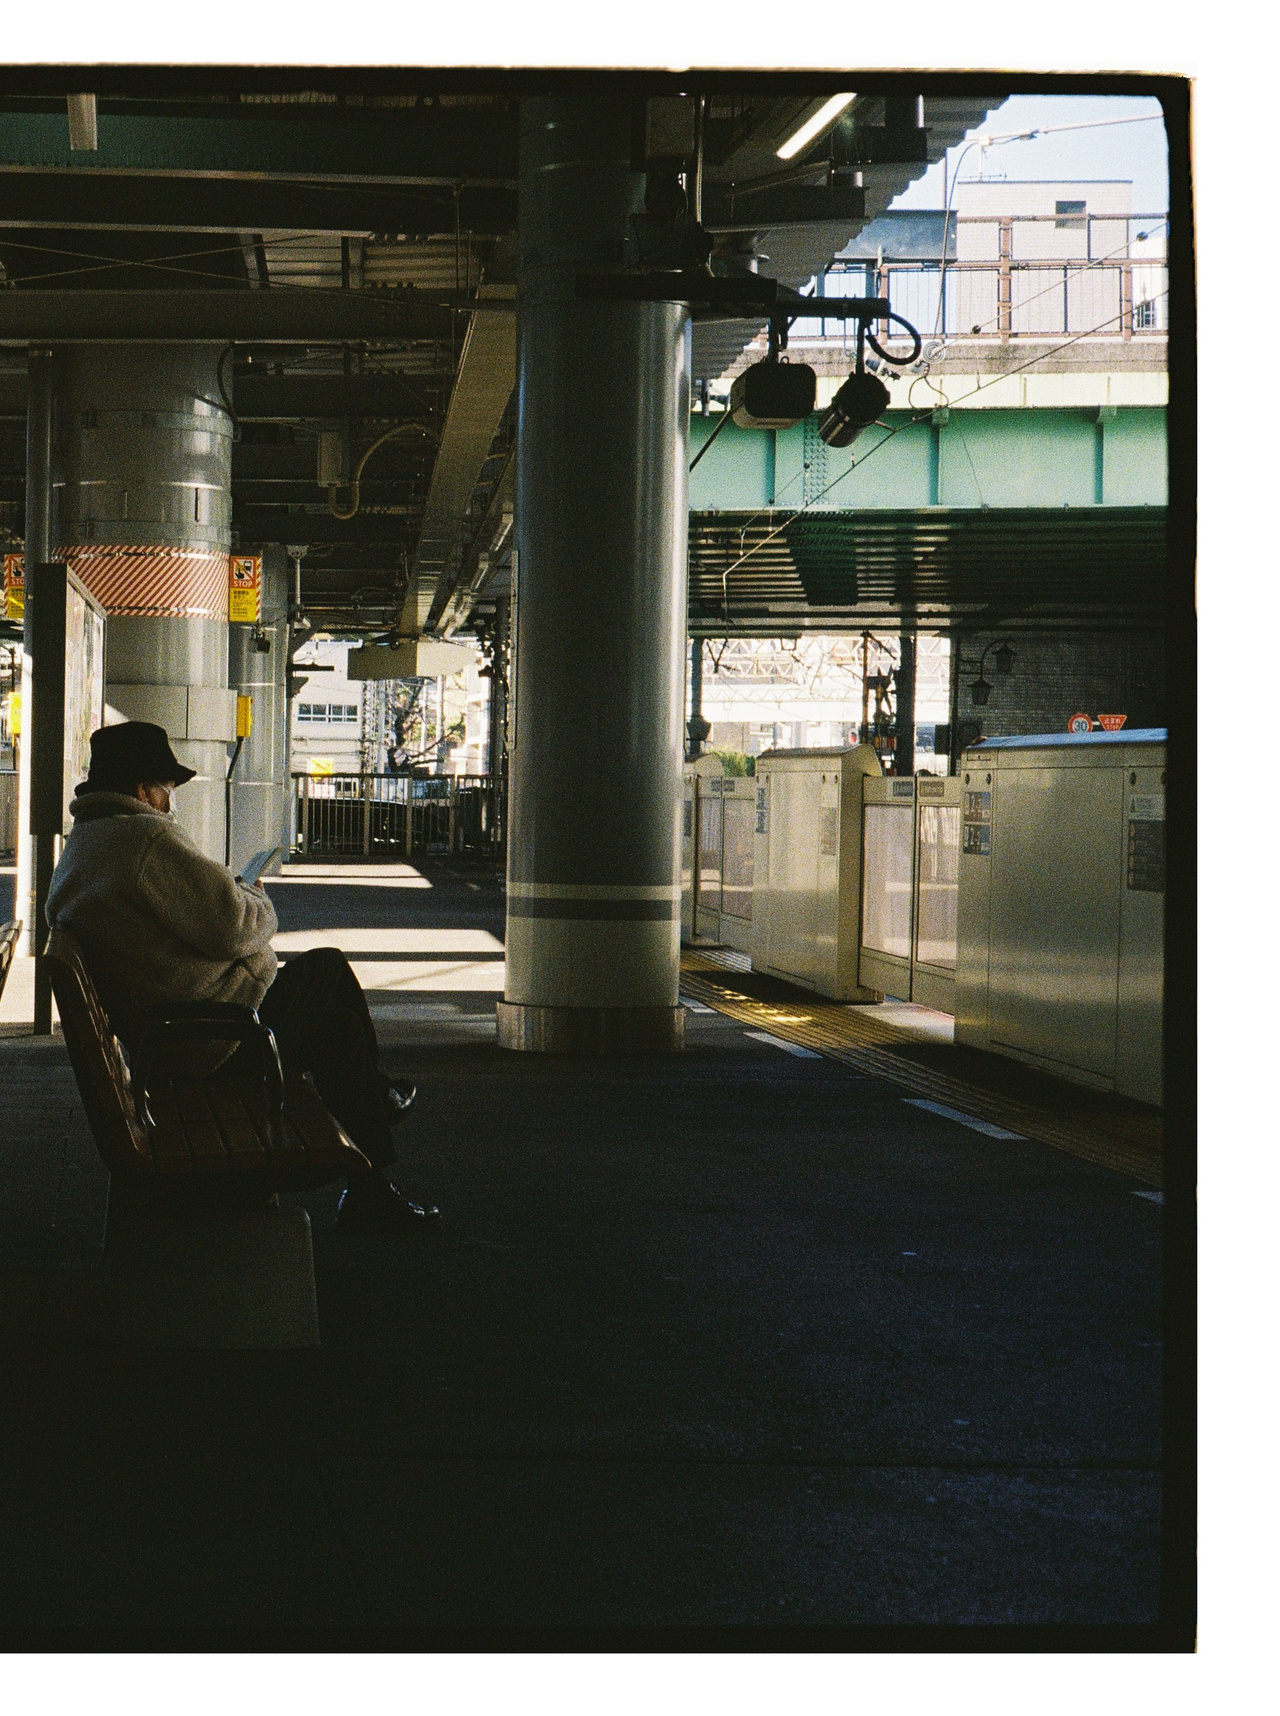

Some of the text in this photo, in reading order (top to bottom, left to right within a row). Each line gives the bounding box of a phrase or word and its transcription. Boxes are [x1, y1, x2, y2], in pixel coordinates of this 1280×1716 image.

[11, 578, 24, 586] STO
[233, 580, 253, 588] STOP
[1074, 720, 1087, 731] 30
